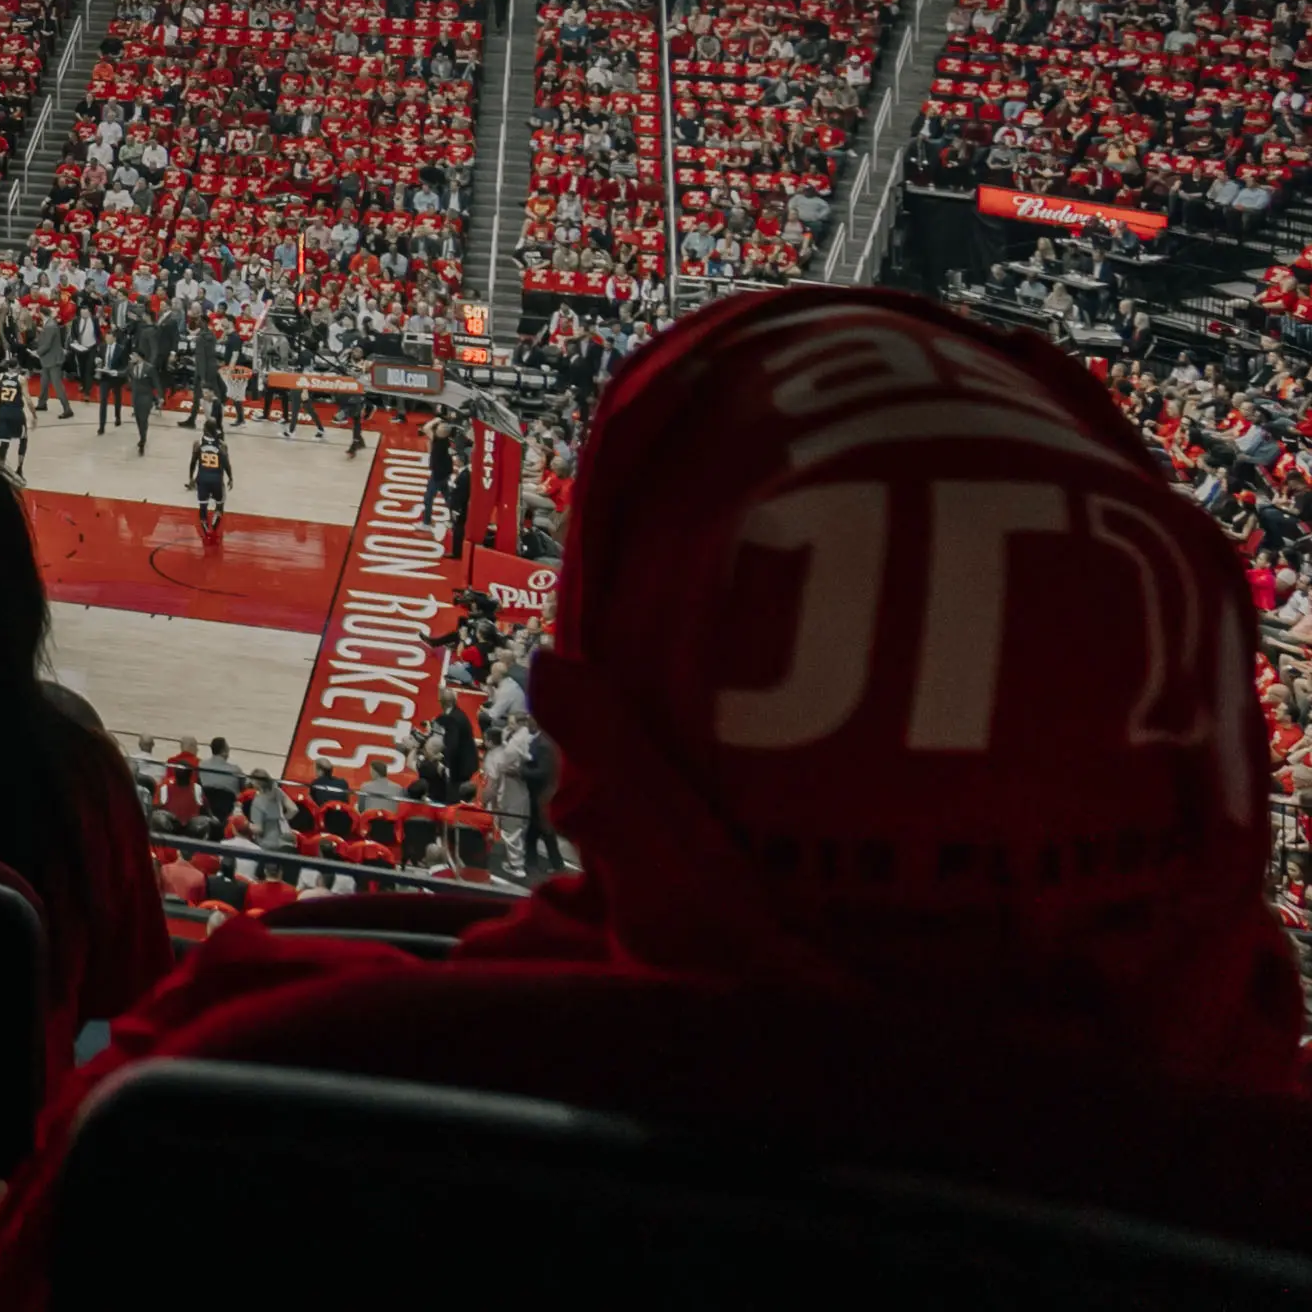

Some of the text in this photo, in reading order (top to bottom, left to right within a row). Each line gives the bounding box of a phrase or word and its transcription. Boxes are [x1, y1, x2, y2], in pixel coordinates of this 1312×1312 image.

[387, 368, 427, 387] NBA.com
[1, 388, 17, 401] 27
[483, 429, 496, 465] NBA
[200, 452, 219, 468] 99
[306, 447, 454, 774] HOUSTON ROCKETS
